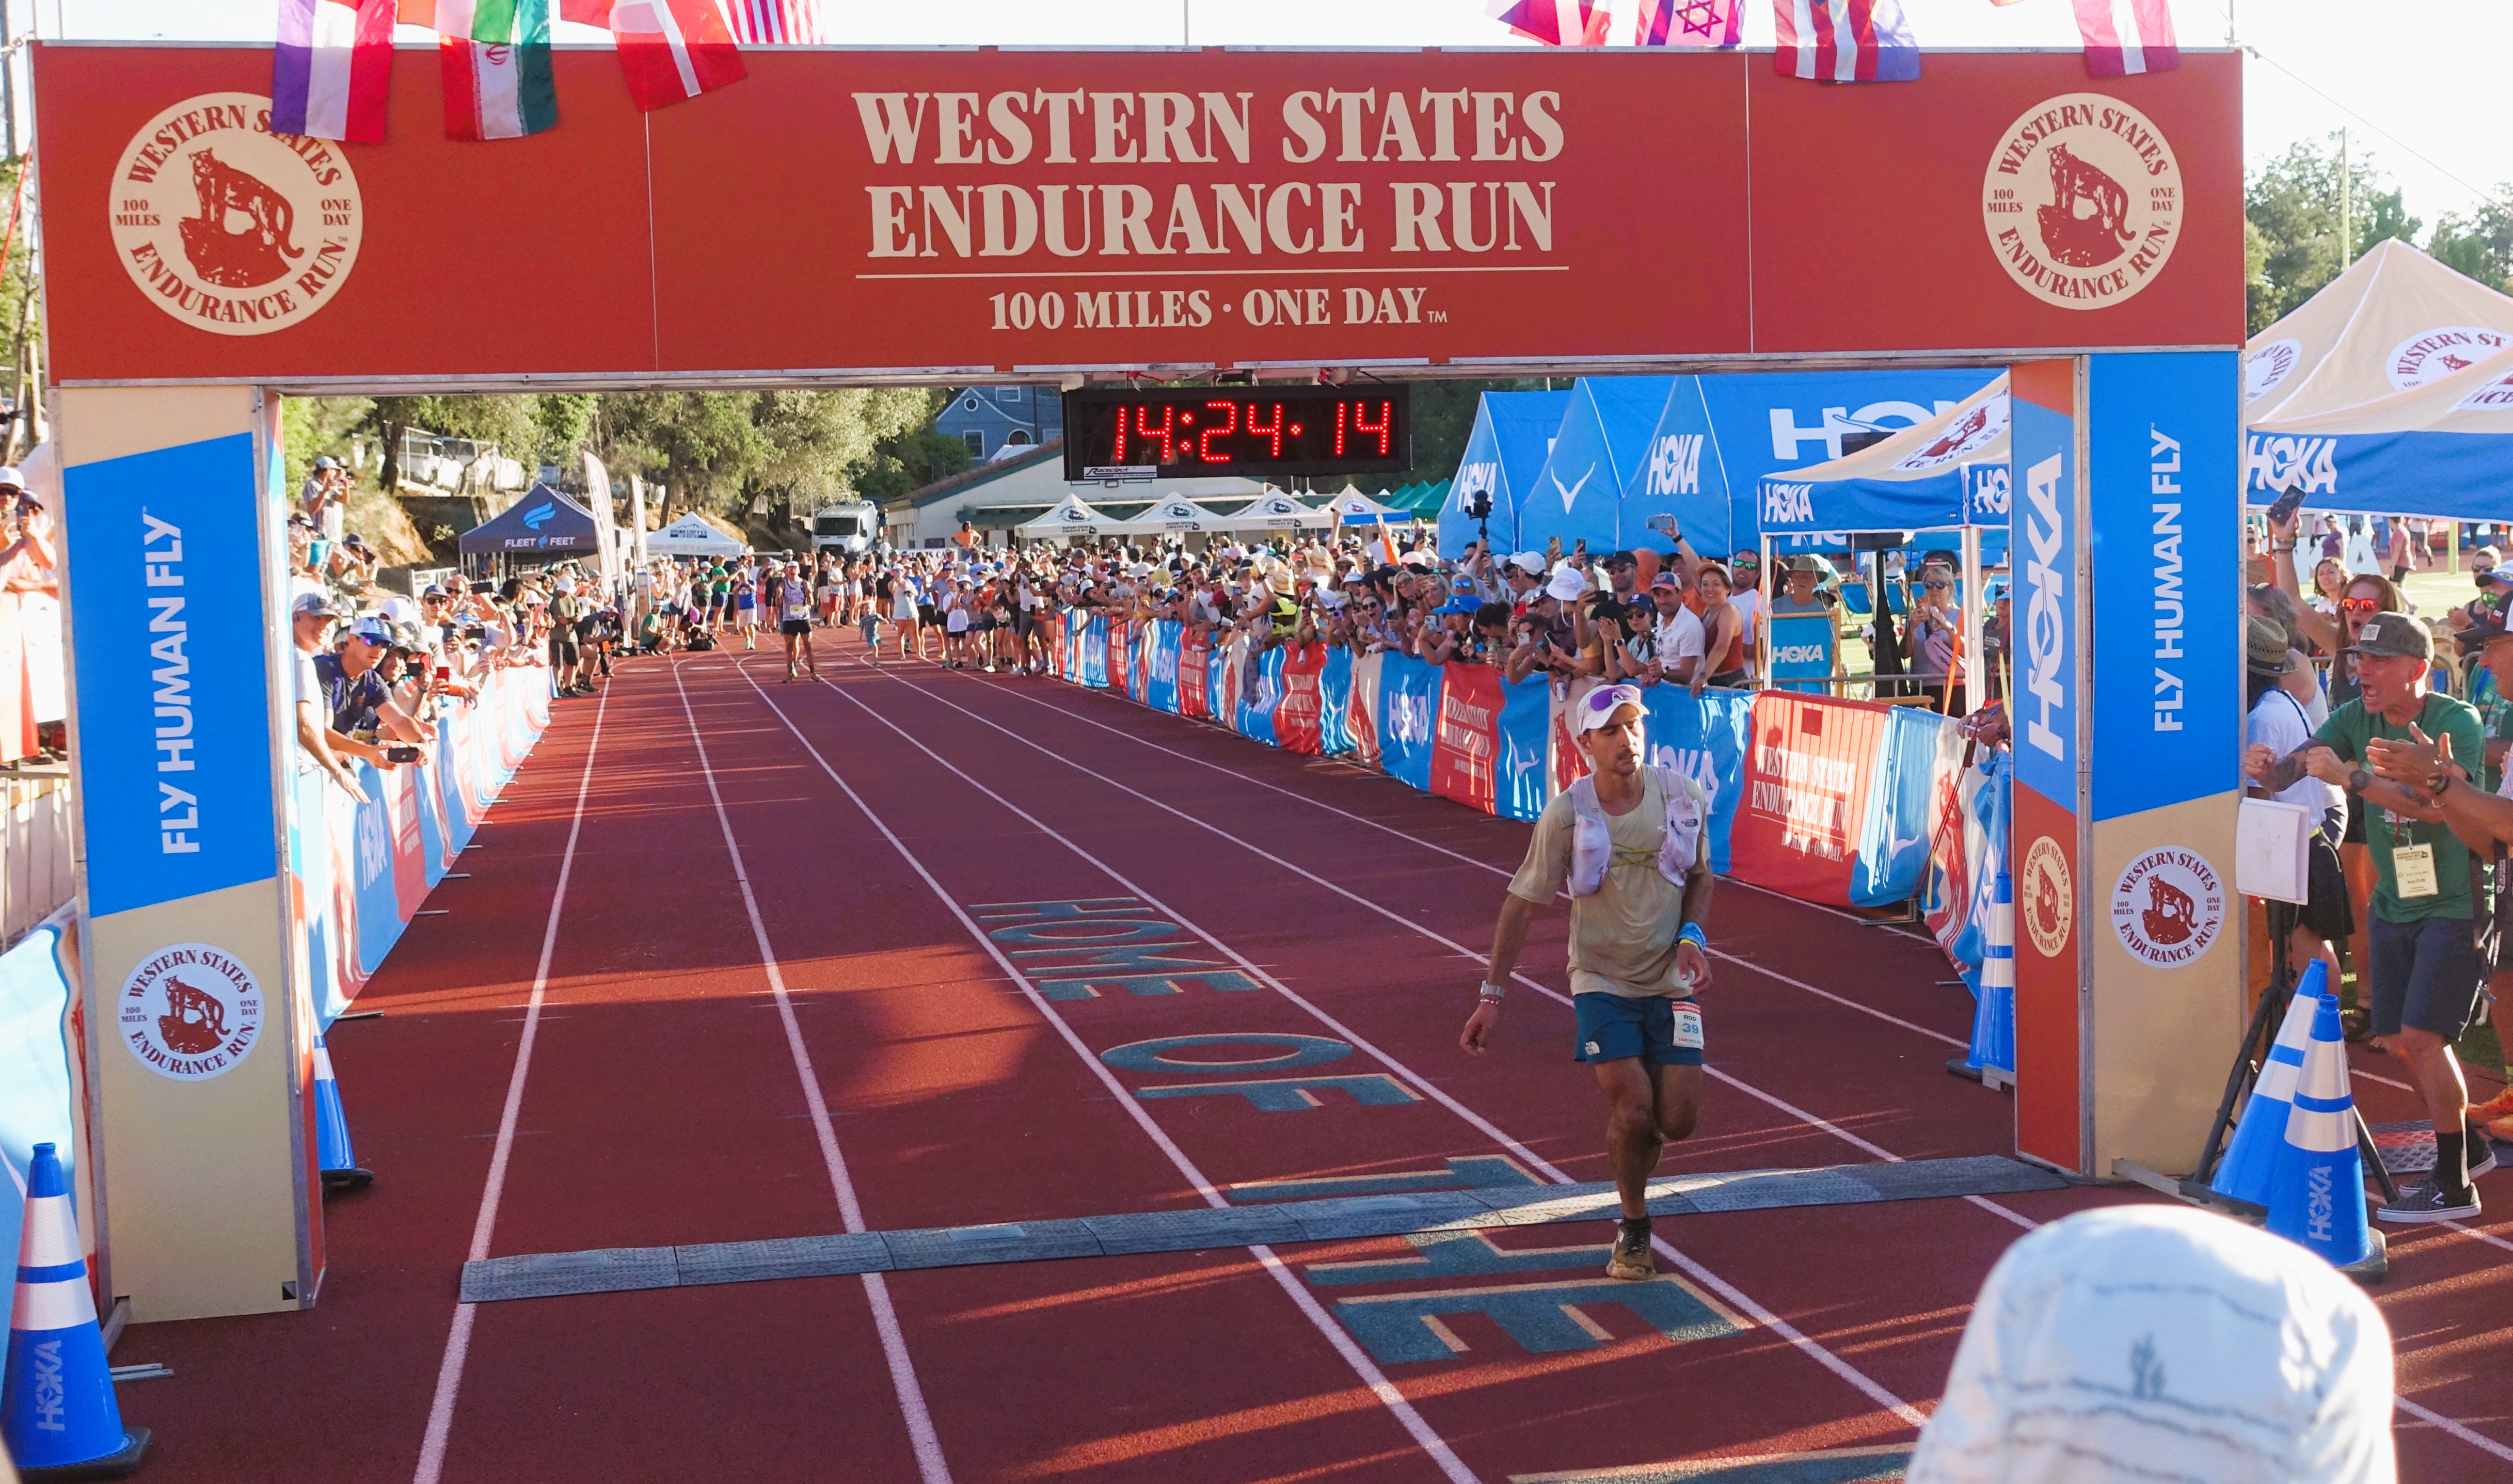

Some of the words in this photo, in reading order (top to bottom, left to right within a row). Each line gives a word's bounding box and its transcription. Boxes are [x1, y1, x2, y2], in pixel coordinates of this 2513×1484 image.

[128, 105, 246, 185] WESTERN
[254, 110, 342, 185] SATES
[851, 88, 1254, 164] WESTERN
[1283, 86, 1564, 163] STATES
[1998, 104, 2094, 175] WESTERN
[2100, 108, 2168, 175] STATES
[123, 200, 148, 211] 100
[321, 199, 351, 210] ONE
[1987, 202, 2022, 213] MILES
[1993, 189, 2014, 199] 100
[2151, 188, 2174, 198] ONE
[2152, 201, 2173, 211] DAY
[115, 215, 160, 226] MILES
[323, 215, 349, 225] DAY
[865, 182, 1364, 258] ENDURANCE
[1389, 180, 1556, 252] RUN
[131, 241, 296, 323] ENDURANCE
[296, 238, 346, 298] RUN
[1998, 226, 2128, 299] ENDURANCE
[2128, 222, 2170, 276] RUN
[989, 291, 1065, 330] 100
[1075, 289, 1212, 328] MILES
[1242, 288, 1329, 326] ONE
[2398, 333, 2472, 374] WESTERN
[1646, 434, 1700, 496] HOKA
[2151, 429, 2181, 494] FLY
[2247, 435, 2337, 494] HOKA
[1764, 483, 1814, 522] HOKA
[142, 513, 184, 587] FLY
[505, 538, 536, 548] FLEET
[549, 537, 575, 546] FEET
[2153, 503, 2184, 658] HUMAN
[2027, 452, 2063, 761] HOKA
[1772, 644, 1824, 663] HOKA
[148, 597, 195, 771] HUMAN
[2155, 667, 2183, 731] FLY
[1757, 744, 1811, 784] WESTERN
[1811, 756, 1855, 795] STATES
[158, 780, 200, 854] FLY
[1751, 780, 1820, 825] ENDURANCE
[1820, 796, 1848, 832] RUN
[2027, 842, 2050, 877] WESTERN
[2051, 846, 2068, 886] STATES
[2120, 852, 2175, 893] WESTERN
[2177, 854, 2217, 891] STATES
[967, 897, 1265, 1001] HOME
[2026, 906, 2058, 951] ENDURANCE
[2120, 922, 2194, 962] ENDURANCE
[2194, 918, 2218, 948] RUN
[128, 950, 197, 997] WESTERN
[200, 951, 252, 993] STATES
[130, 1030, 227, 1074] ENDURANCE
[226, 1023, 256, 1058] RUN
[1682, 1023, 1698, 1034] 39
[1100, 1032, 1425, 1113] OF
[2309, 1166, 2332, 1241] HOKA
[34, 1340, 65, 1431] HOKA
